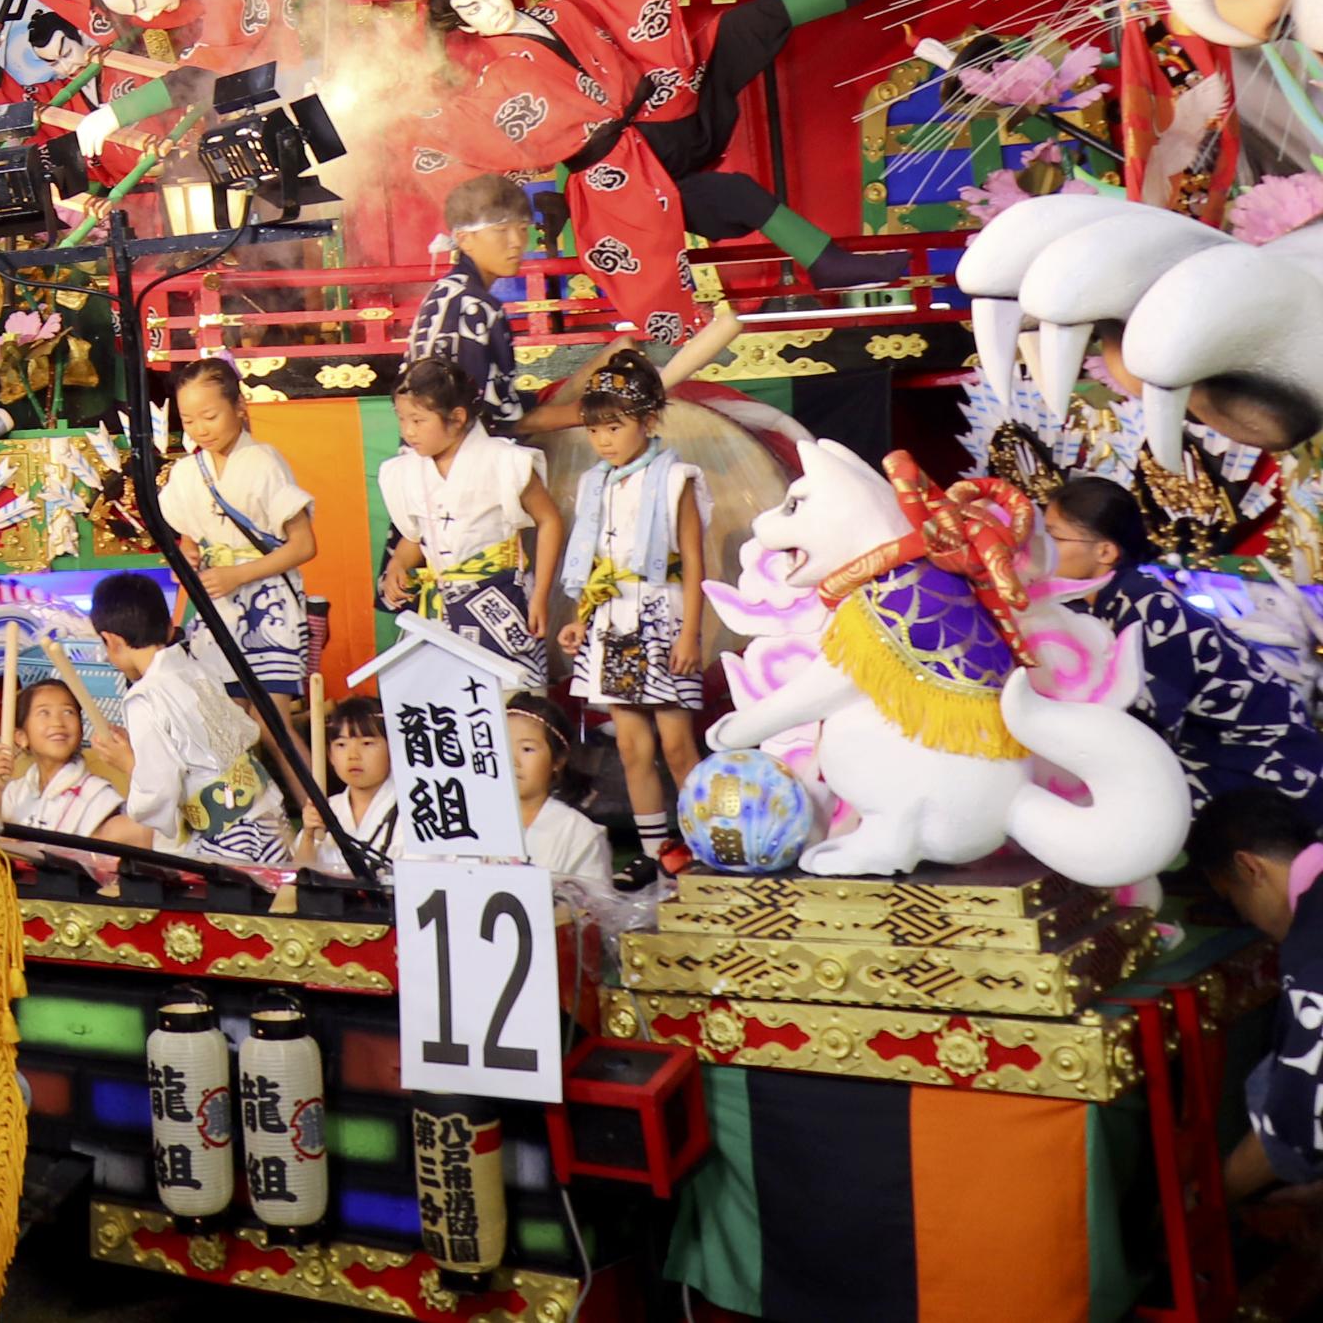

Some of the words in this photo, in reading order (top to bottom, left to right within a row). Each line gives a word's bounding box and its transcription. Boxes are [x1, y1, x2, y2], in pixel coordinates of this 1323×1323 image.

[395, 702, 479, 843] 龍組
[461, 675, 499, 779] 十一日町
[417, 889, 538, 1072] 12
